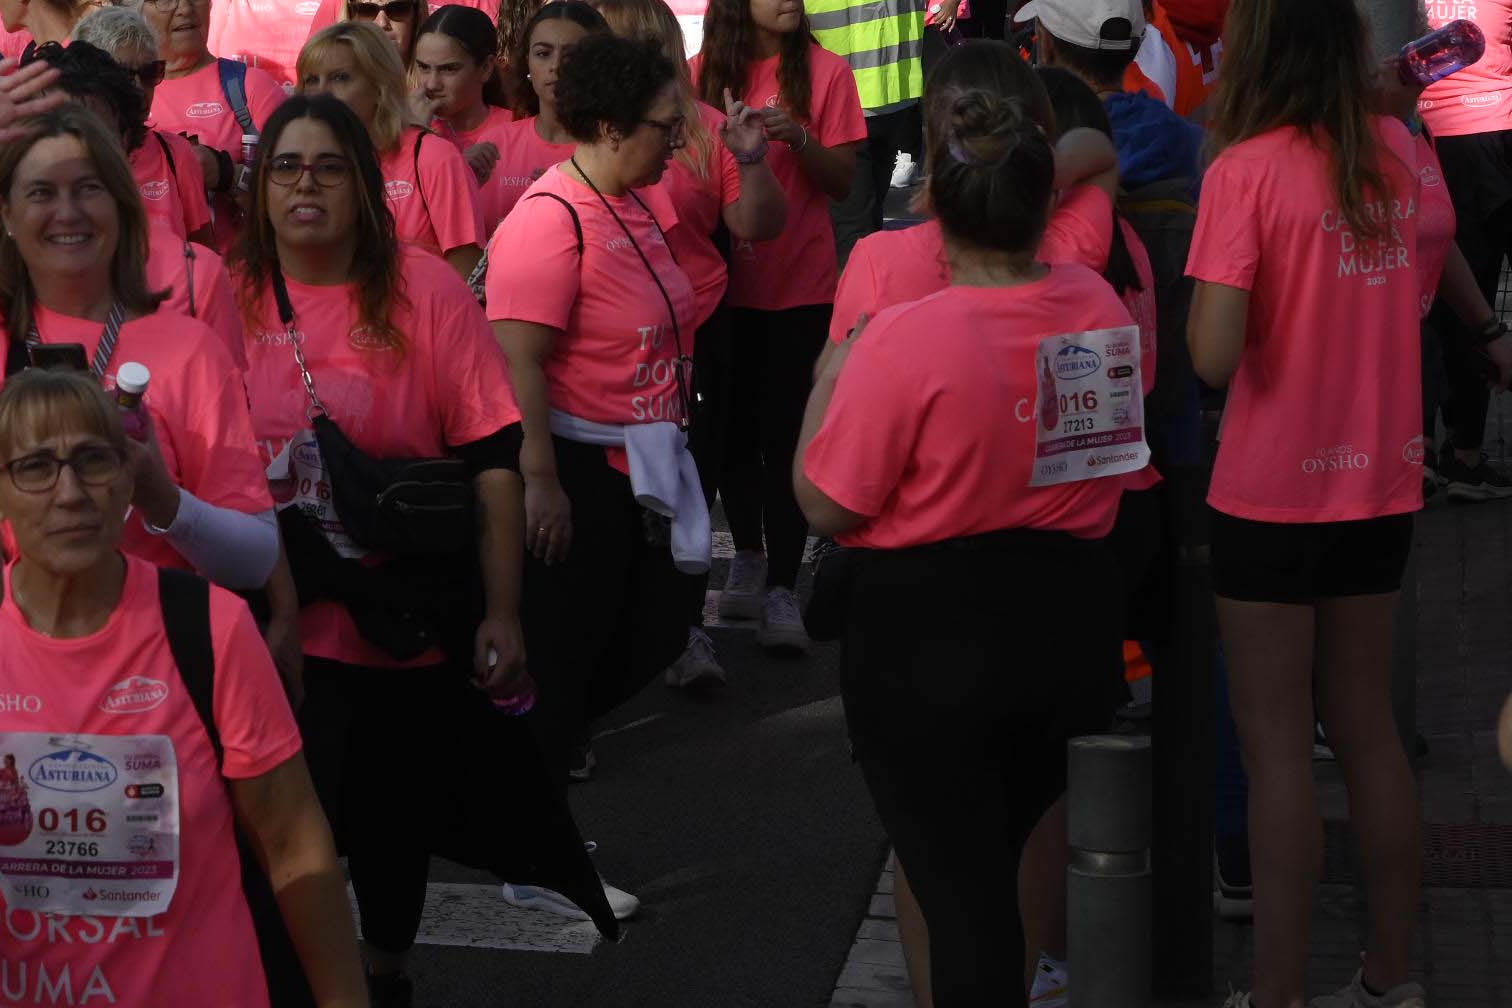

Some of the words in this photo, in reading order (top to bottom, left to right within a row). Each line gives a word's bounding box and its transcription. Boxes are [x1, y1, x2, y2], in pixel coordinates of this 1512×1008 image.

[1337, 246, 1411, 278] MUJER
[637, 325, 665, 351] TU
[1059, 390, 1098, 414] 016
[1302, 453, 1369, 474] OYSHO
[104, 686, 165, 707] ASTURIANA
[36, 764, 112, 784] ASTURIANA
[123, 759, 162, 772] SUMA
[38, 807, 108, 834] 016
[45, 840, 99, 858] 23766
[50, 863, 67, 873] DE
[69, 863, 84, 874] LA
[86, 864, 127, 876] MUJER
[100, 890, 161, 903] Santander
